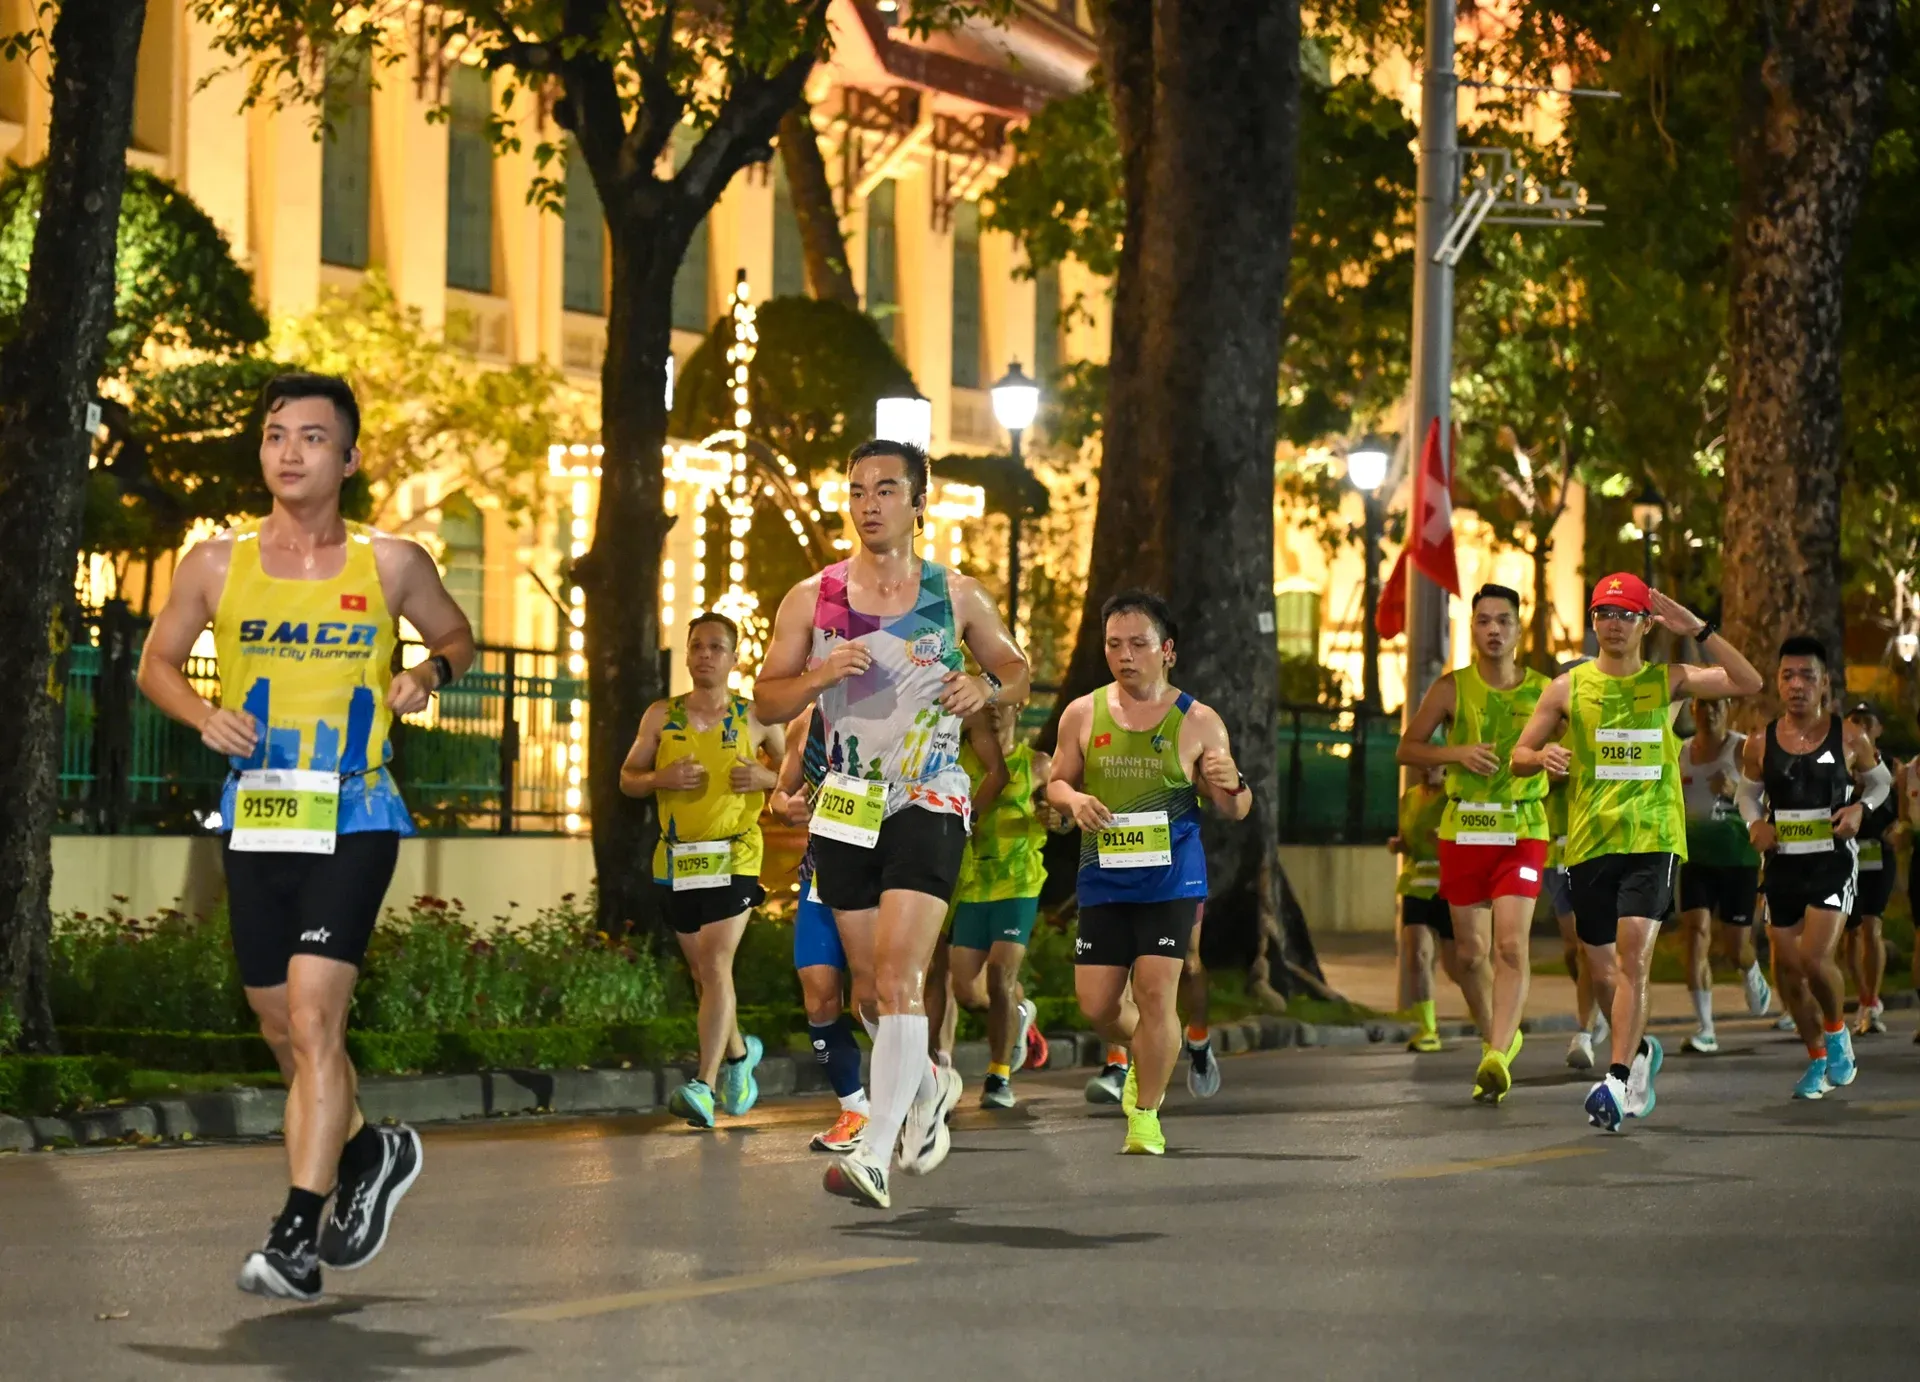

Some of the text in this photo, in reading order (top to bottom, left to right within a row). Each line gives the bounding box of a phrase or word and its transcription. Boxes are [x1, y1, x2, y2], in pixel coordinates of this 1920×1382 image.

[239, 620, 378, 646] SMCR
[279, 647, 305, 661] City
[309, 648, 371, 659] Runners
[914, 644, 938, 655] HFC
[1601, 746, 1642, 760] 91842
[1099, 756, 1141, 768] THANH
[1104, 769, 1159, 780] RUNNERS
[243, 797, 298, 818] 91578
[821, 792, 855, 816] 91718
[1460, 814, 1497, 827] 90506
[1103, 831, 1144, 847] 91144
[677, 857, 709, 872] 91795
